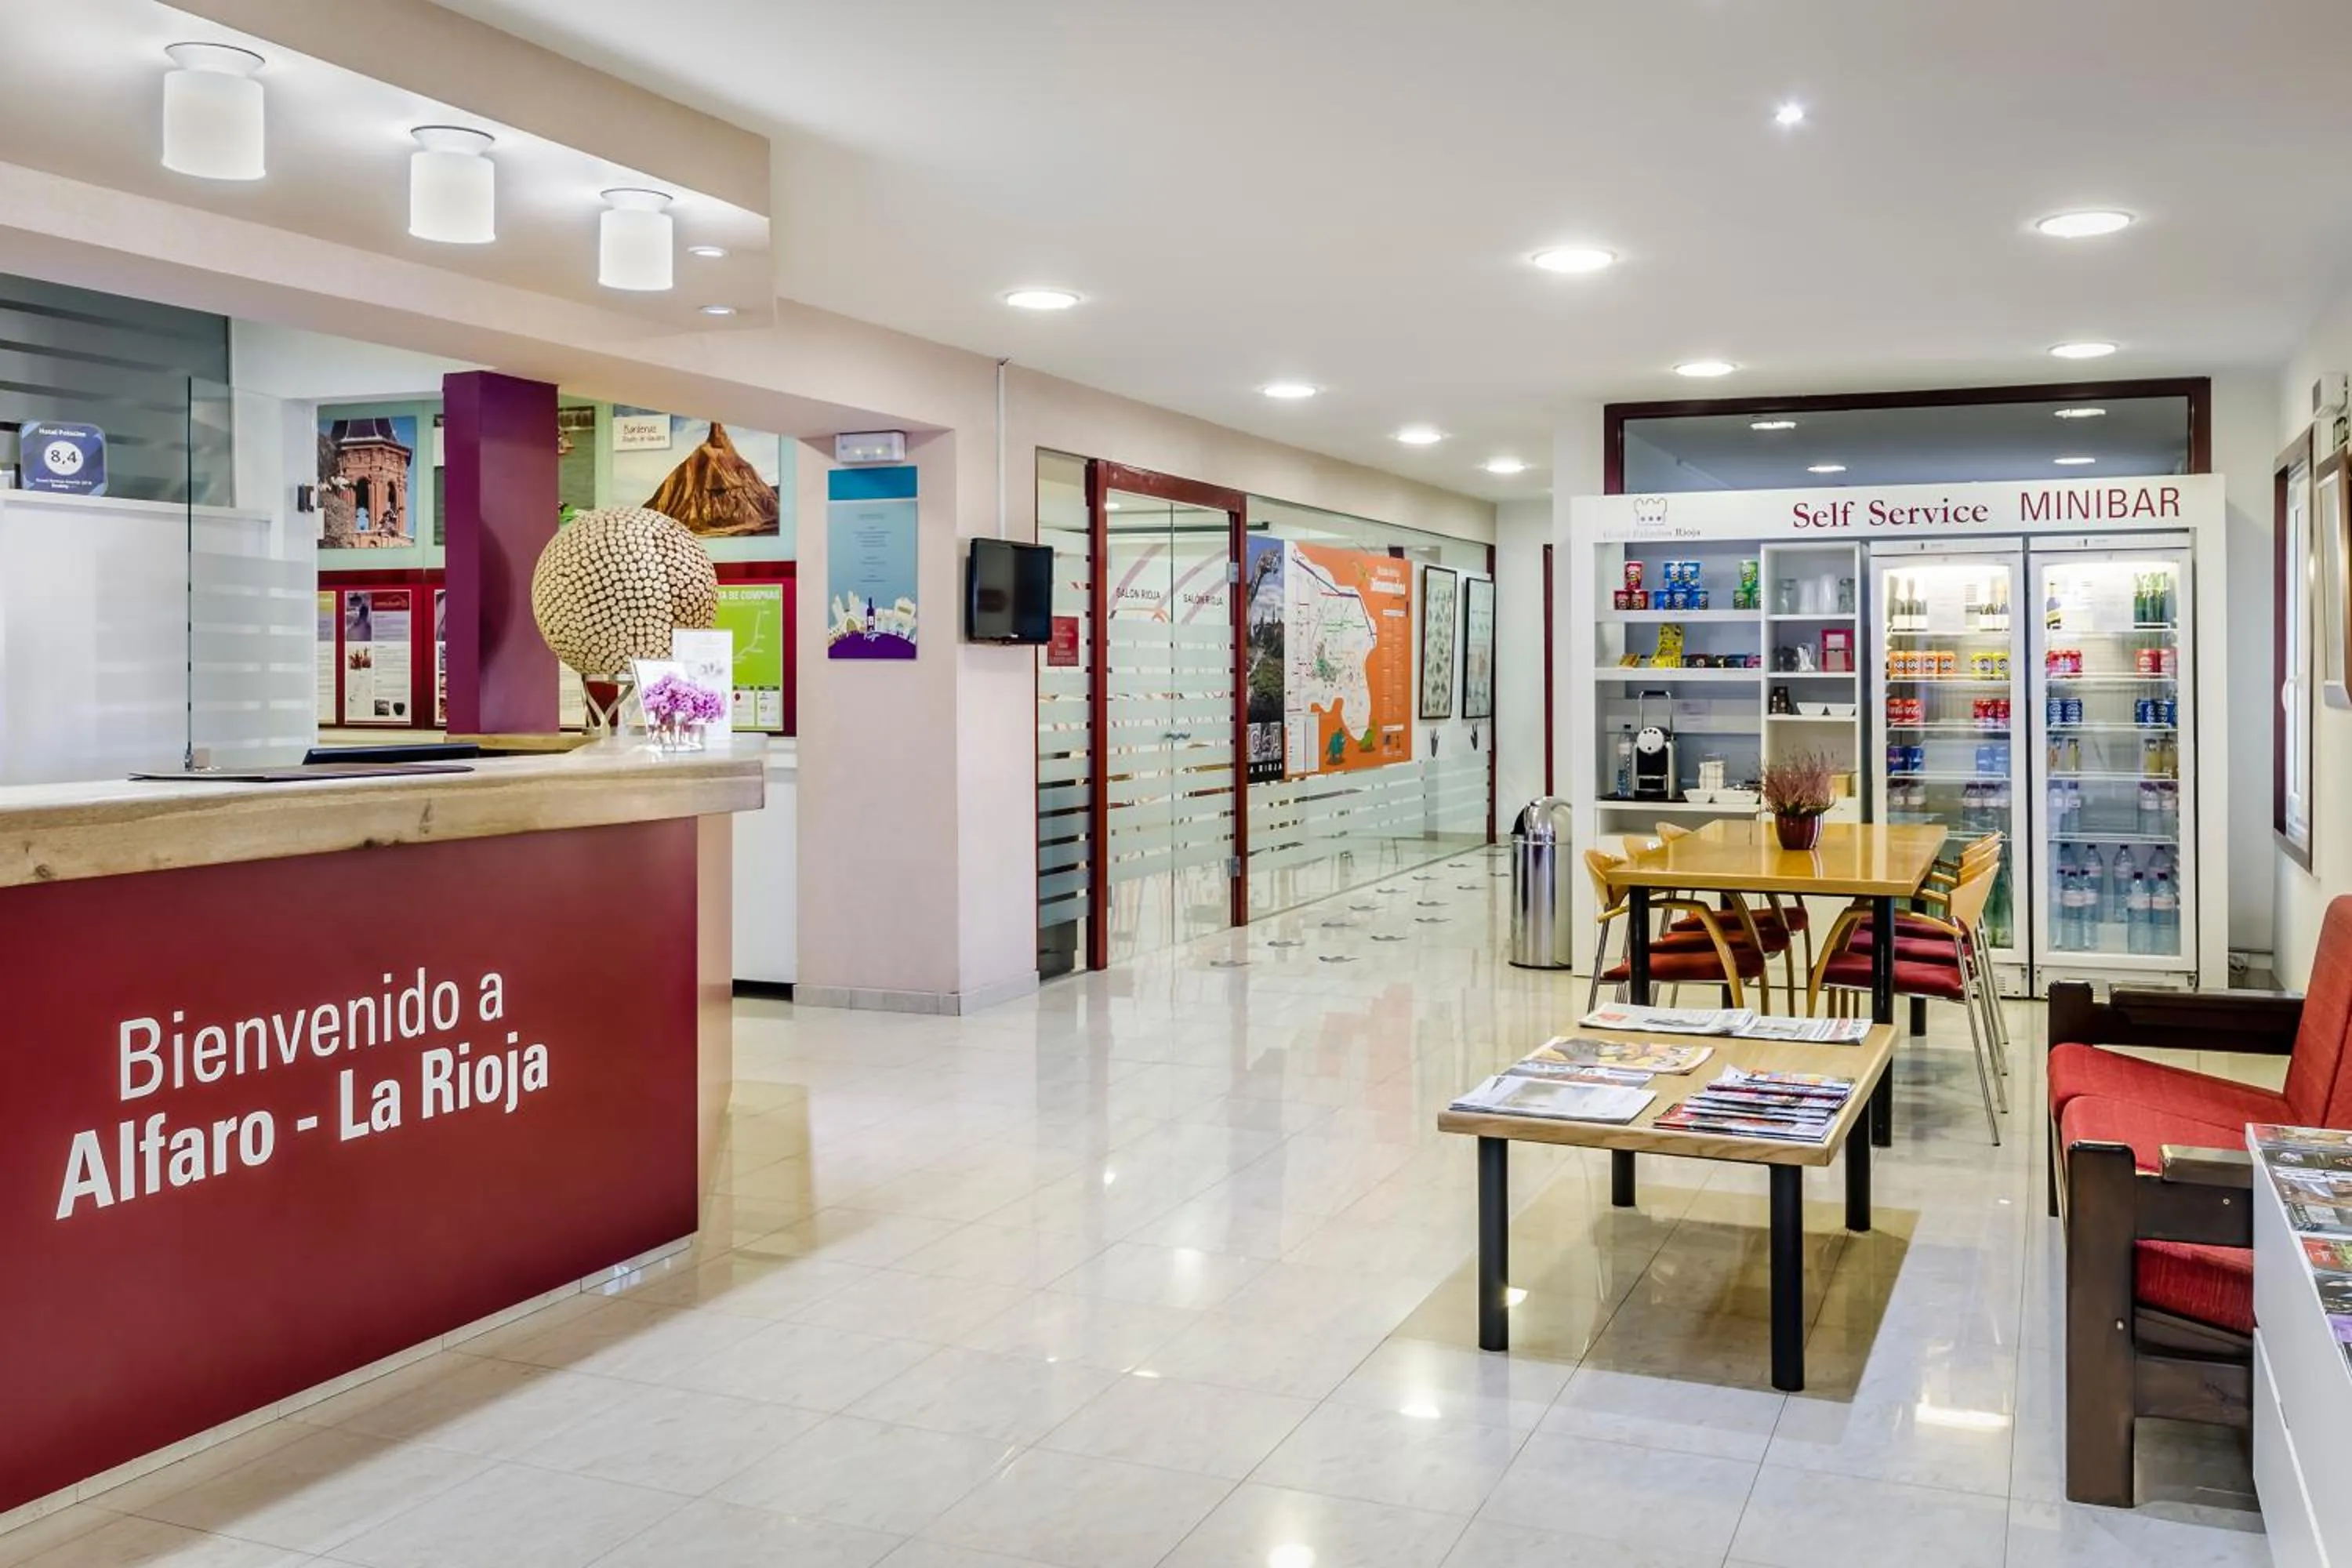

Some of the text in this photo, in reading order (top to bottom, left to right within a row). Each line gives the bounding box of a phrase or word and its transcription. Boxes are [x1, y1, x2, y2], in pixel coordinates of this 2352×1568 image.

[50, 449, 77, 465] 8,4
[1792, 486, 2180, 528] Self Service MINIBAR
[1141, 589, 1160, 600] RIOJA
[119, 967, 503, 1102] Bienvenido a
[55, 1031, 550, 1221] Alfaro - La Rioja
